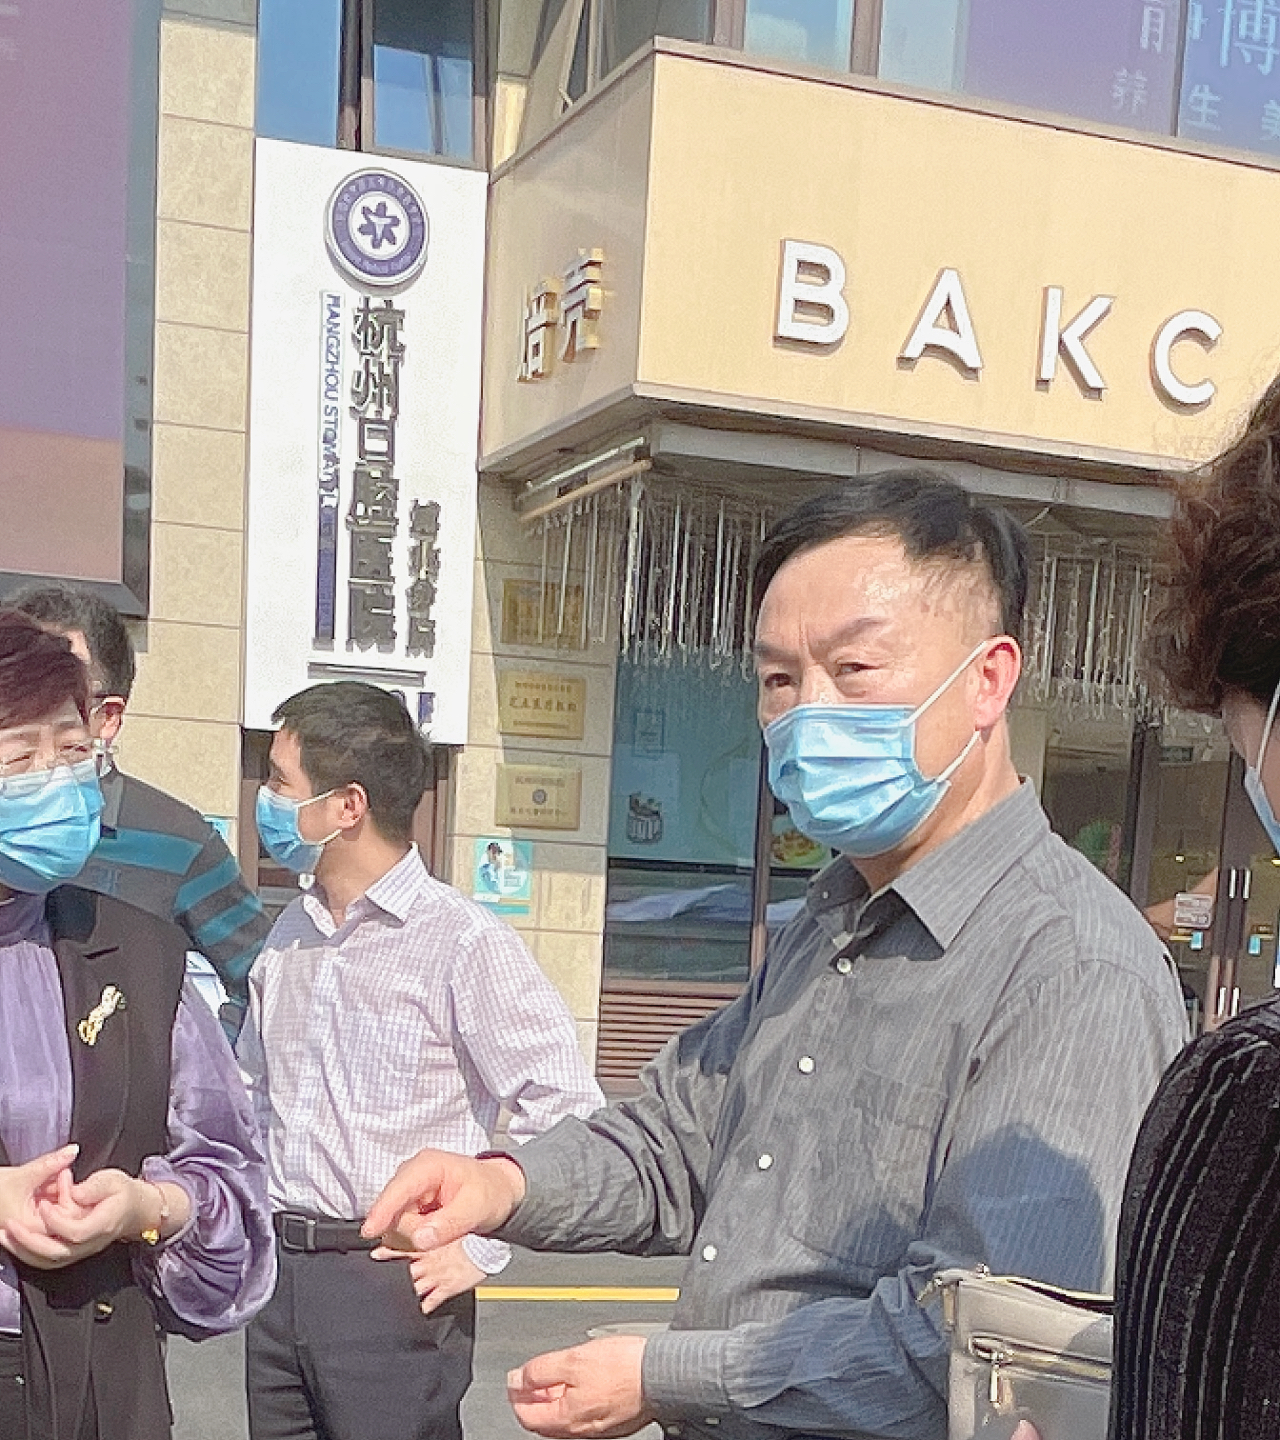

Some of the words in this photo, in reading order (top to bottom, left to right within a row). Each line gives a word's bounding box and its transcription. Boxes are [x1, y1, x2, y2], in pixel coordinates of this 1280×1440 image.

[325, 293, 341, 401] HANGZHOU
[345, 296, 406, 653] 杭州口腔医院
